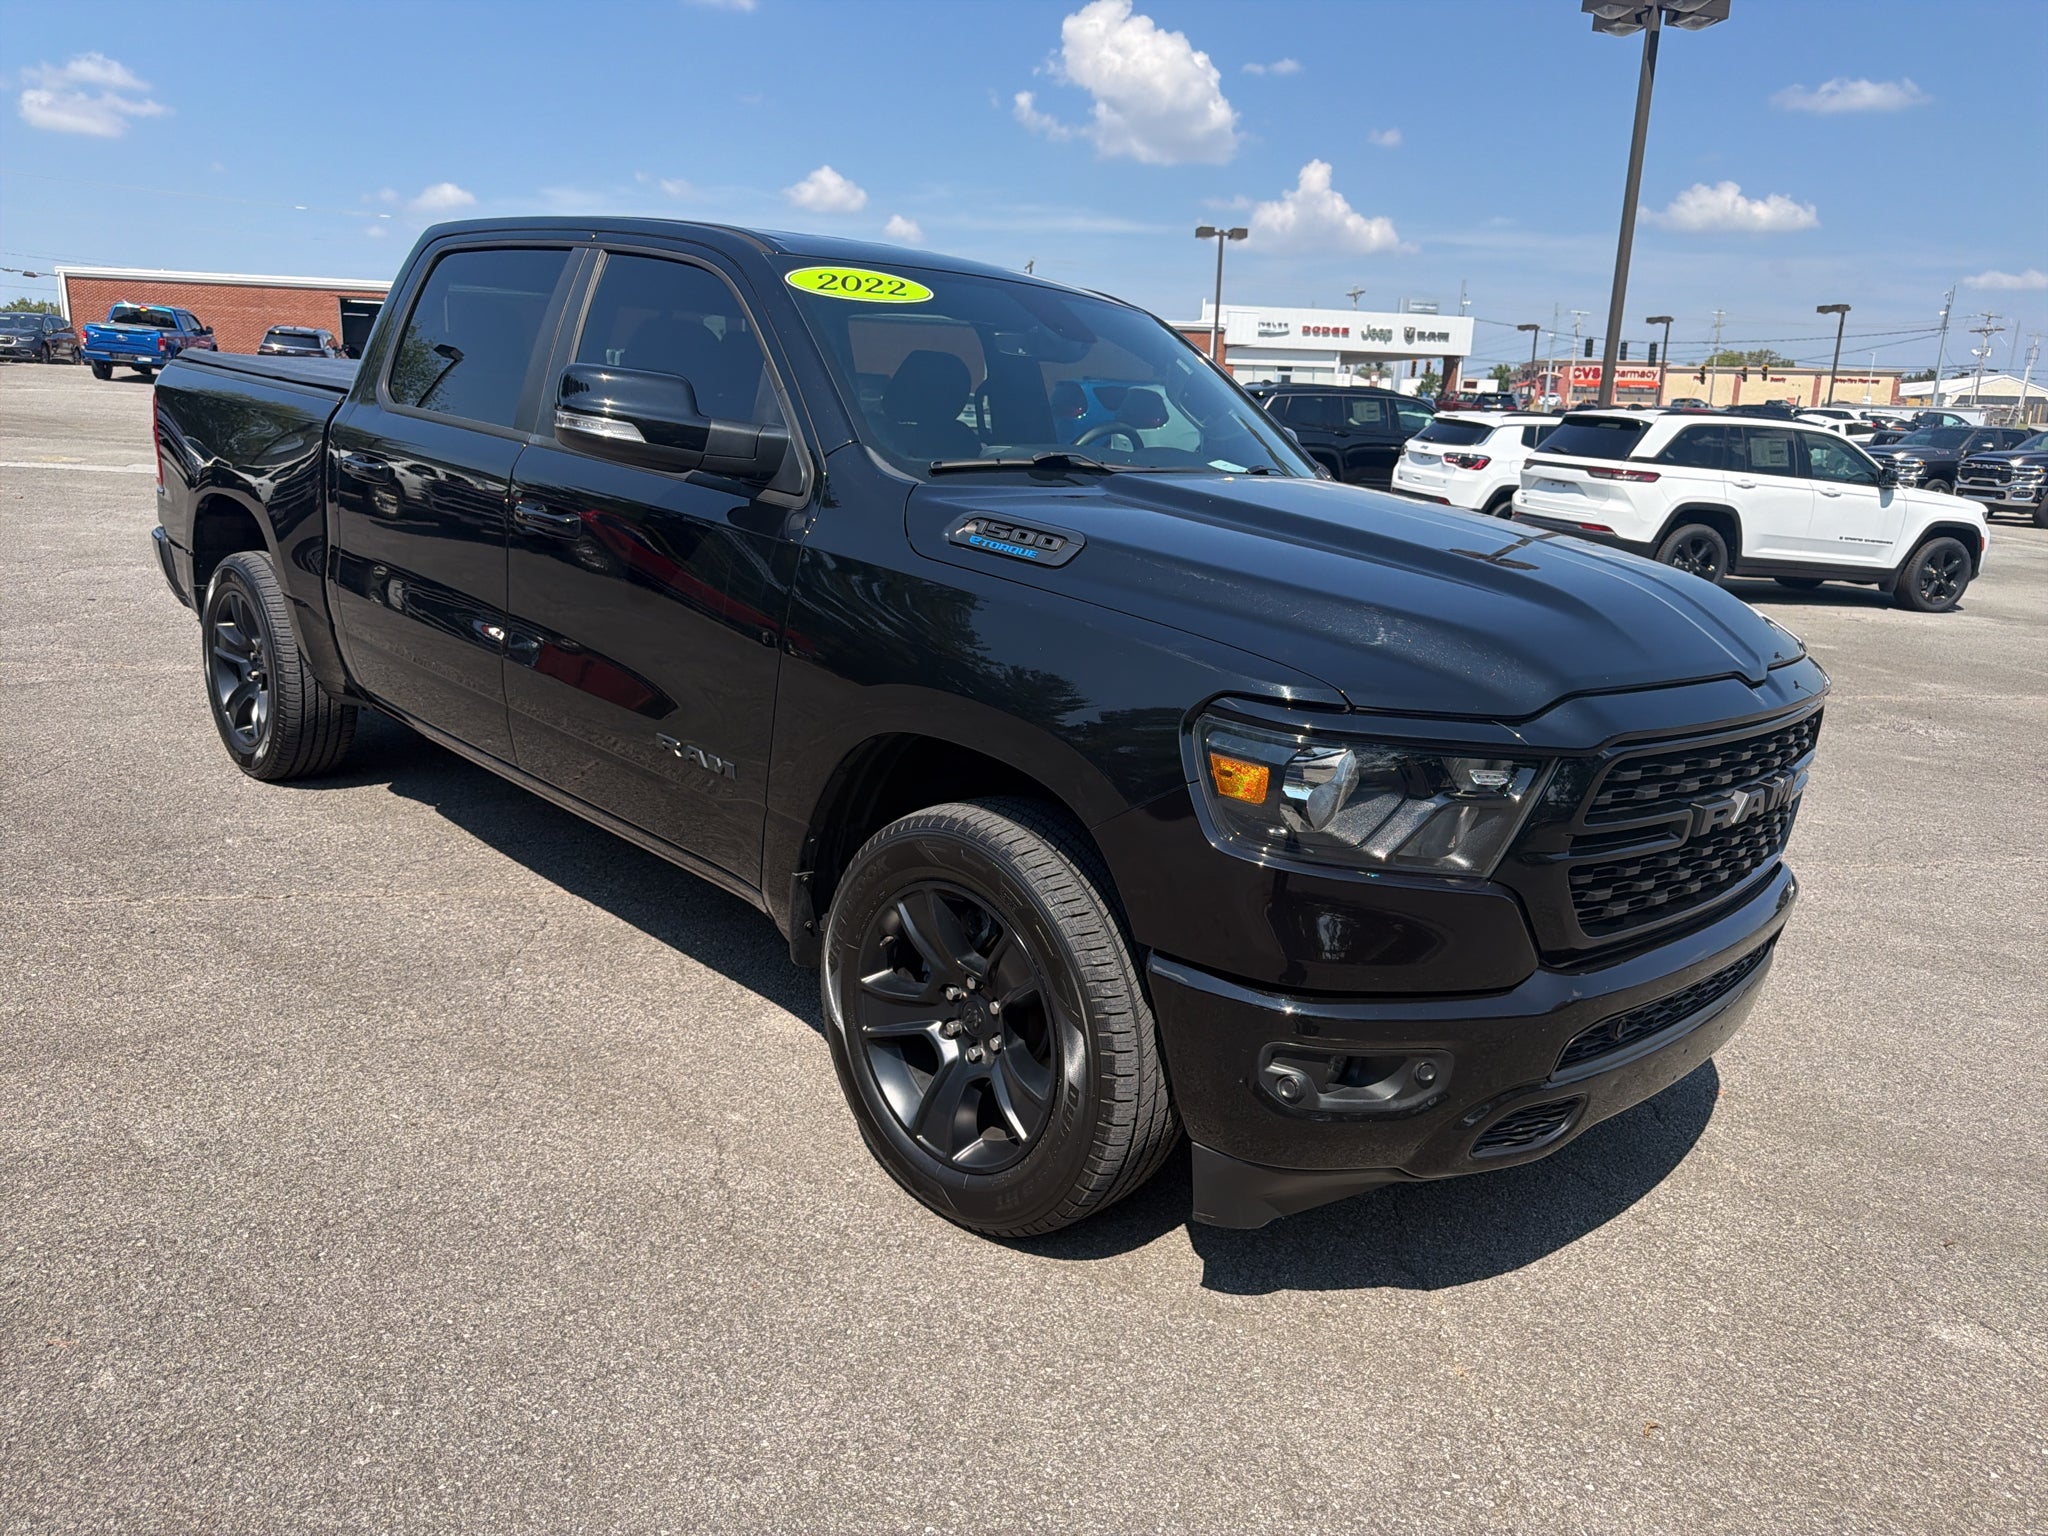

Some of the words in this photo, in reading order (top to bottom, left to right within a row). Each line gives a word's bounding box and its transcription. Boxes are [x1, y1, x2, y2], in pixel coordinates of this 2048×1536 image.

[817, 273, 907, 297] 2022
[1302, 326, 1349, 338] DODGE
[1361, 324, 1392, 344] Jeep
[1417, 331, 1449, 342] RAM
[1574, 367, 1601, 379] CVS
[1615, 369, 1658, 379] harmacy
[961, 518, 1067, 551] 1500
[656, 732, 737, 780] RAM
[1690, 770, 1796, 837] RAM
